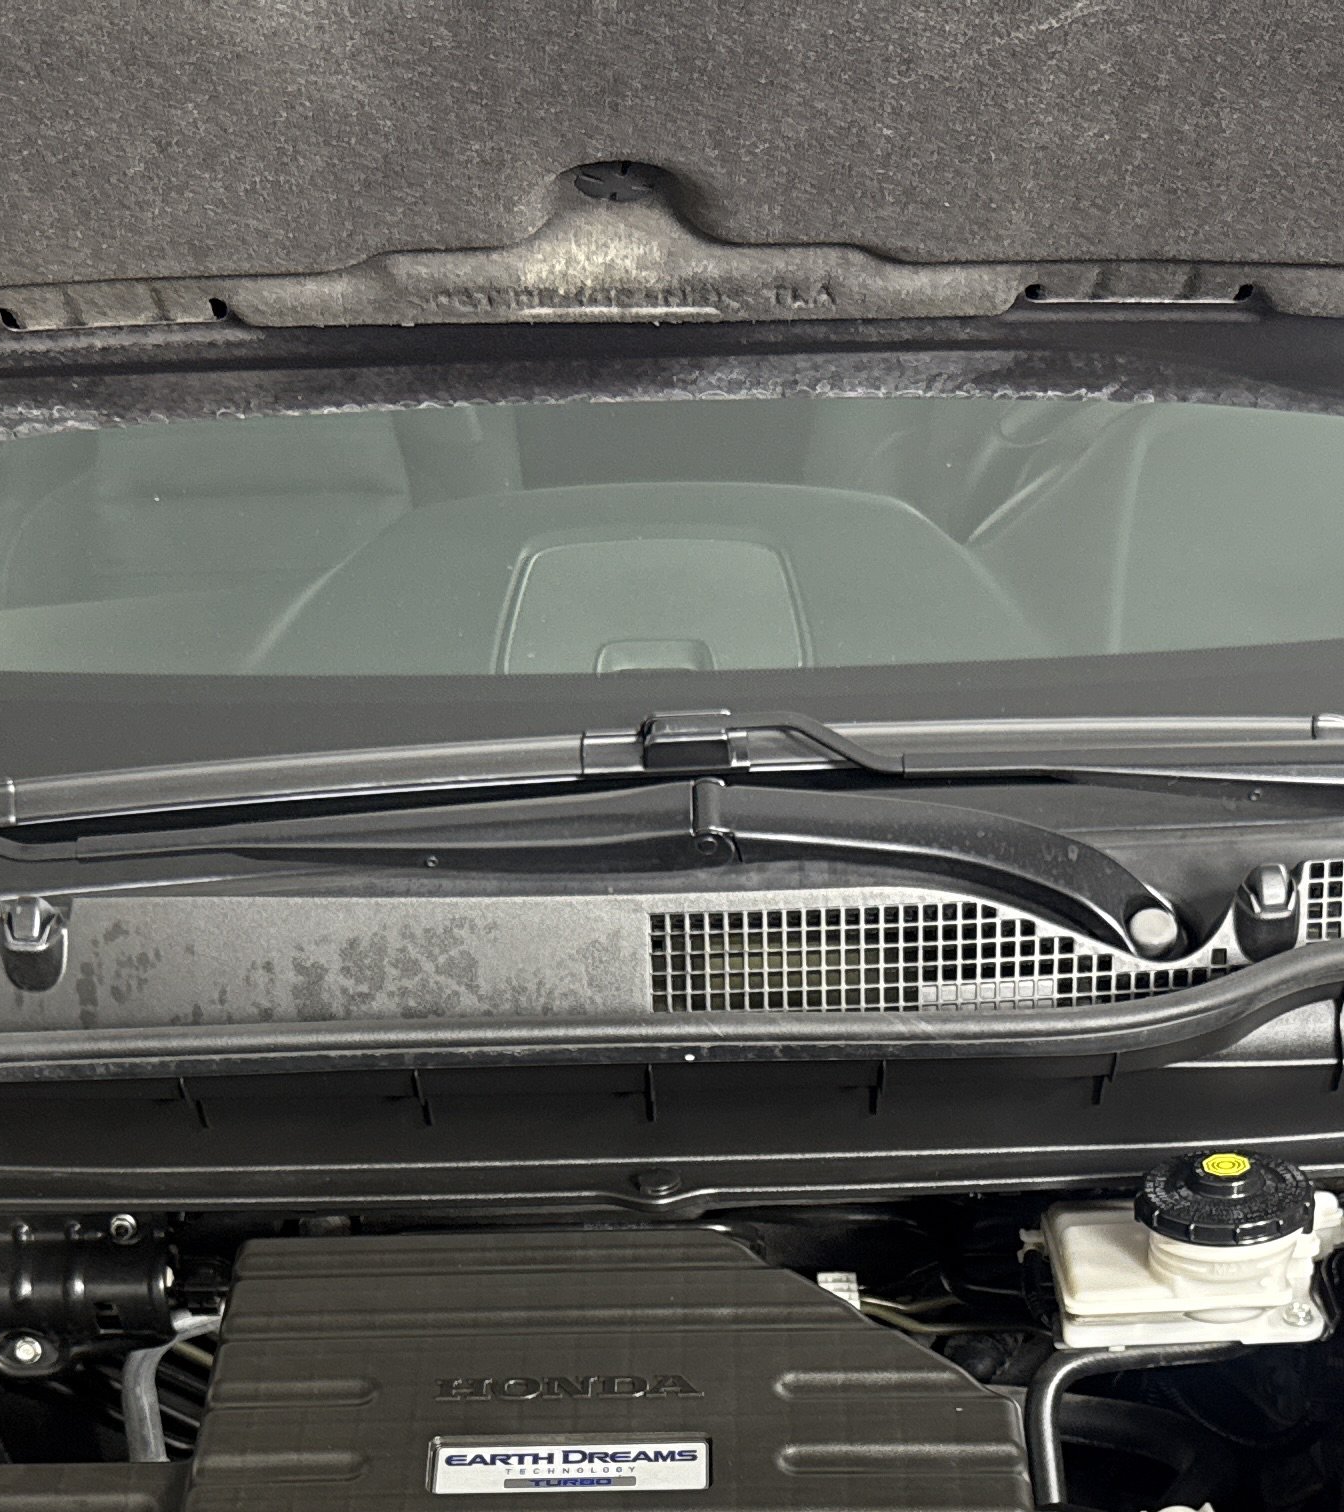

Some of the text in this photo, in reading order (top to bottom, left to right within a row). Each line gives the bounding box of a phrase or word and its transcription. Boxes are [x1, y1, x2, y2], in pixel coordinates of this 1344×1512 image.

[435, 1374, 705, 1401] HONDA
[444, 1449, 698, 1467] EARTH DREAMS
[504, 1465, 636, 1475] TECHNOLOGY
[528, 1477, 613, 1488] TURBO
